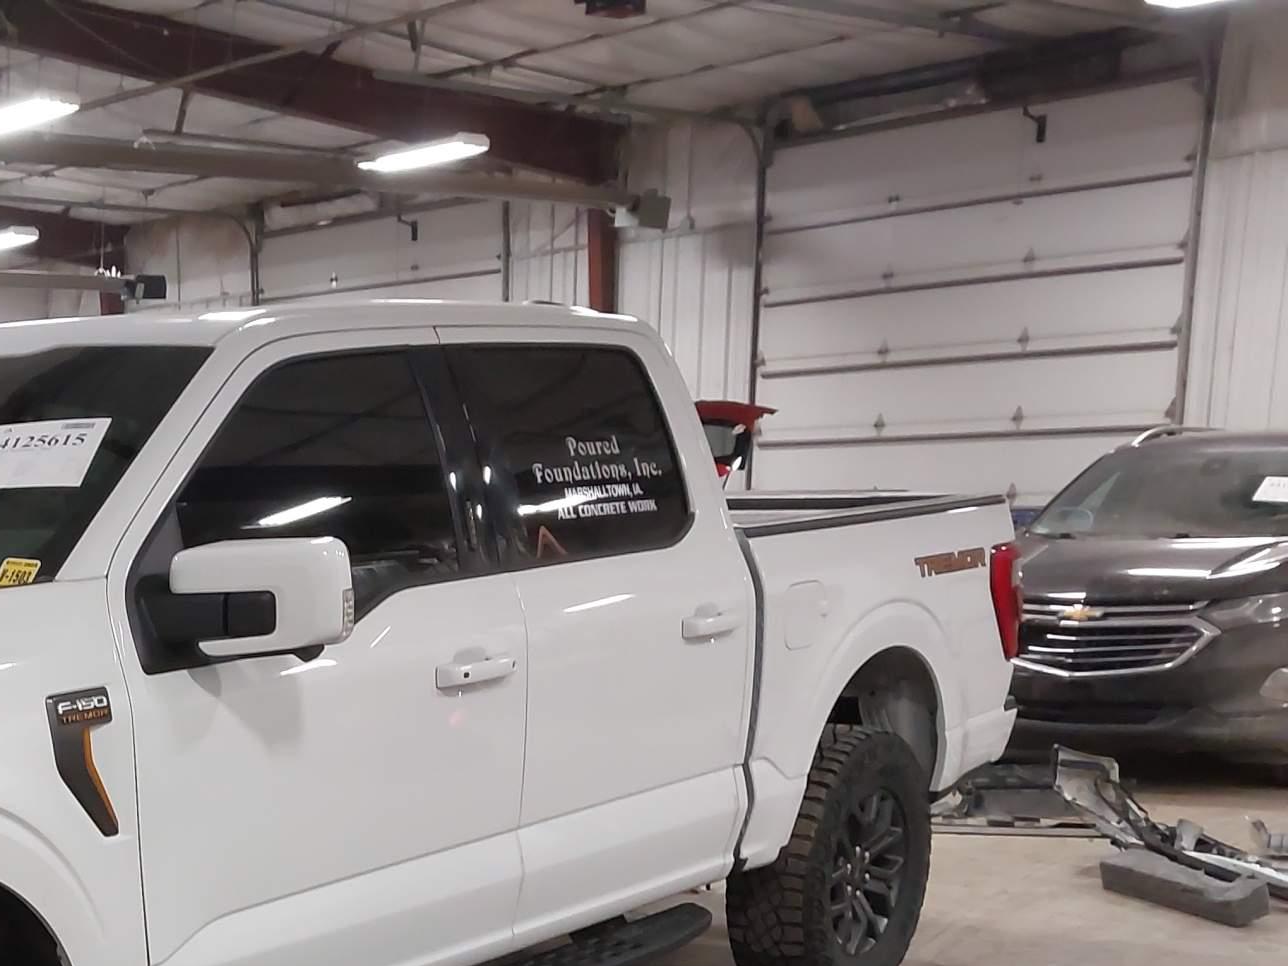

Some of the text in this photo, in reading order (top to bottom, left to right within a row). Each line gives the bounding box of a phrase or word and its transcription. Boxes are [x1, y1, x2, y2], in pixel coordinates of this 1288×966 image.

[566, 435, 620, 456] Poured
[634, 457, 662, 479] Inc.
[557, 499, 658, 520] ALL CONCRETE WORK
[914, 547, 987, 578] TREMOR
[58, 696, 107, 715] F-150
